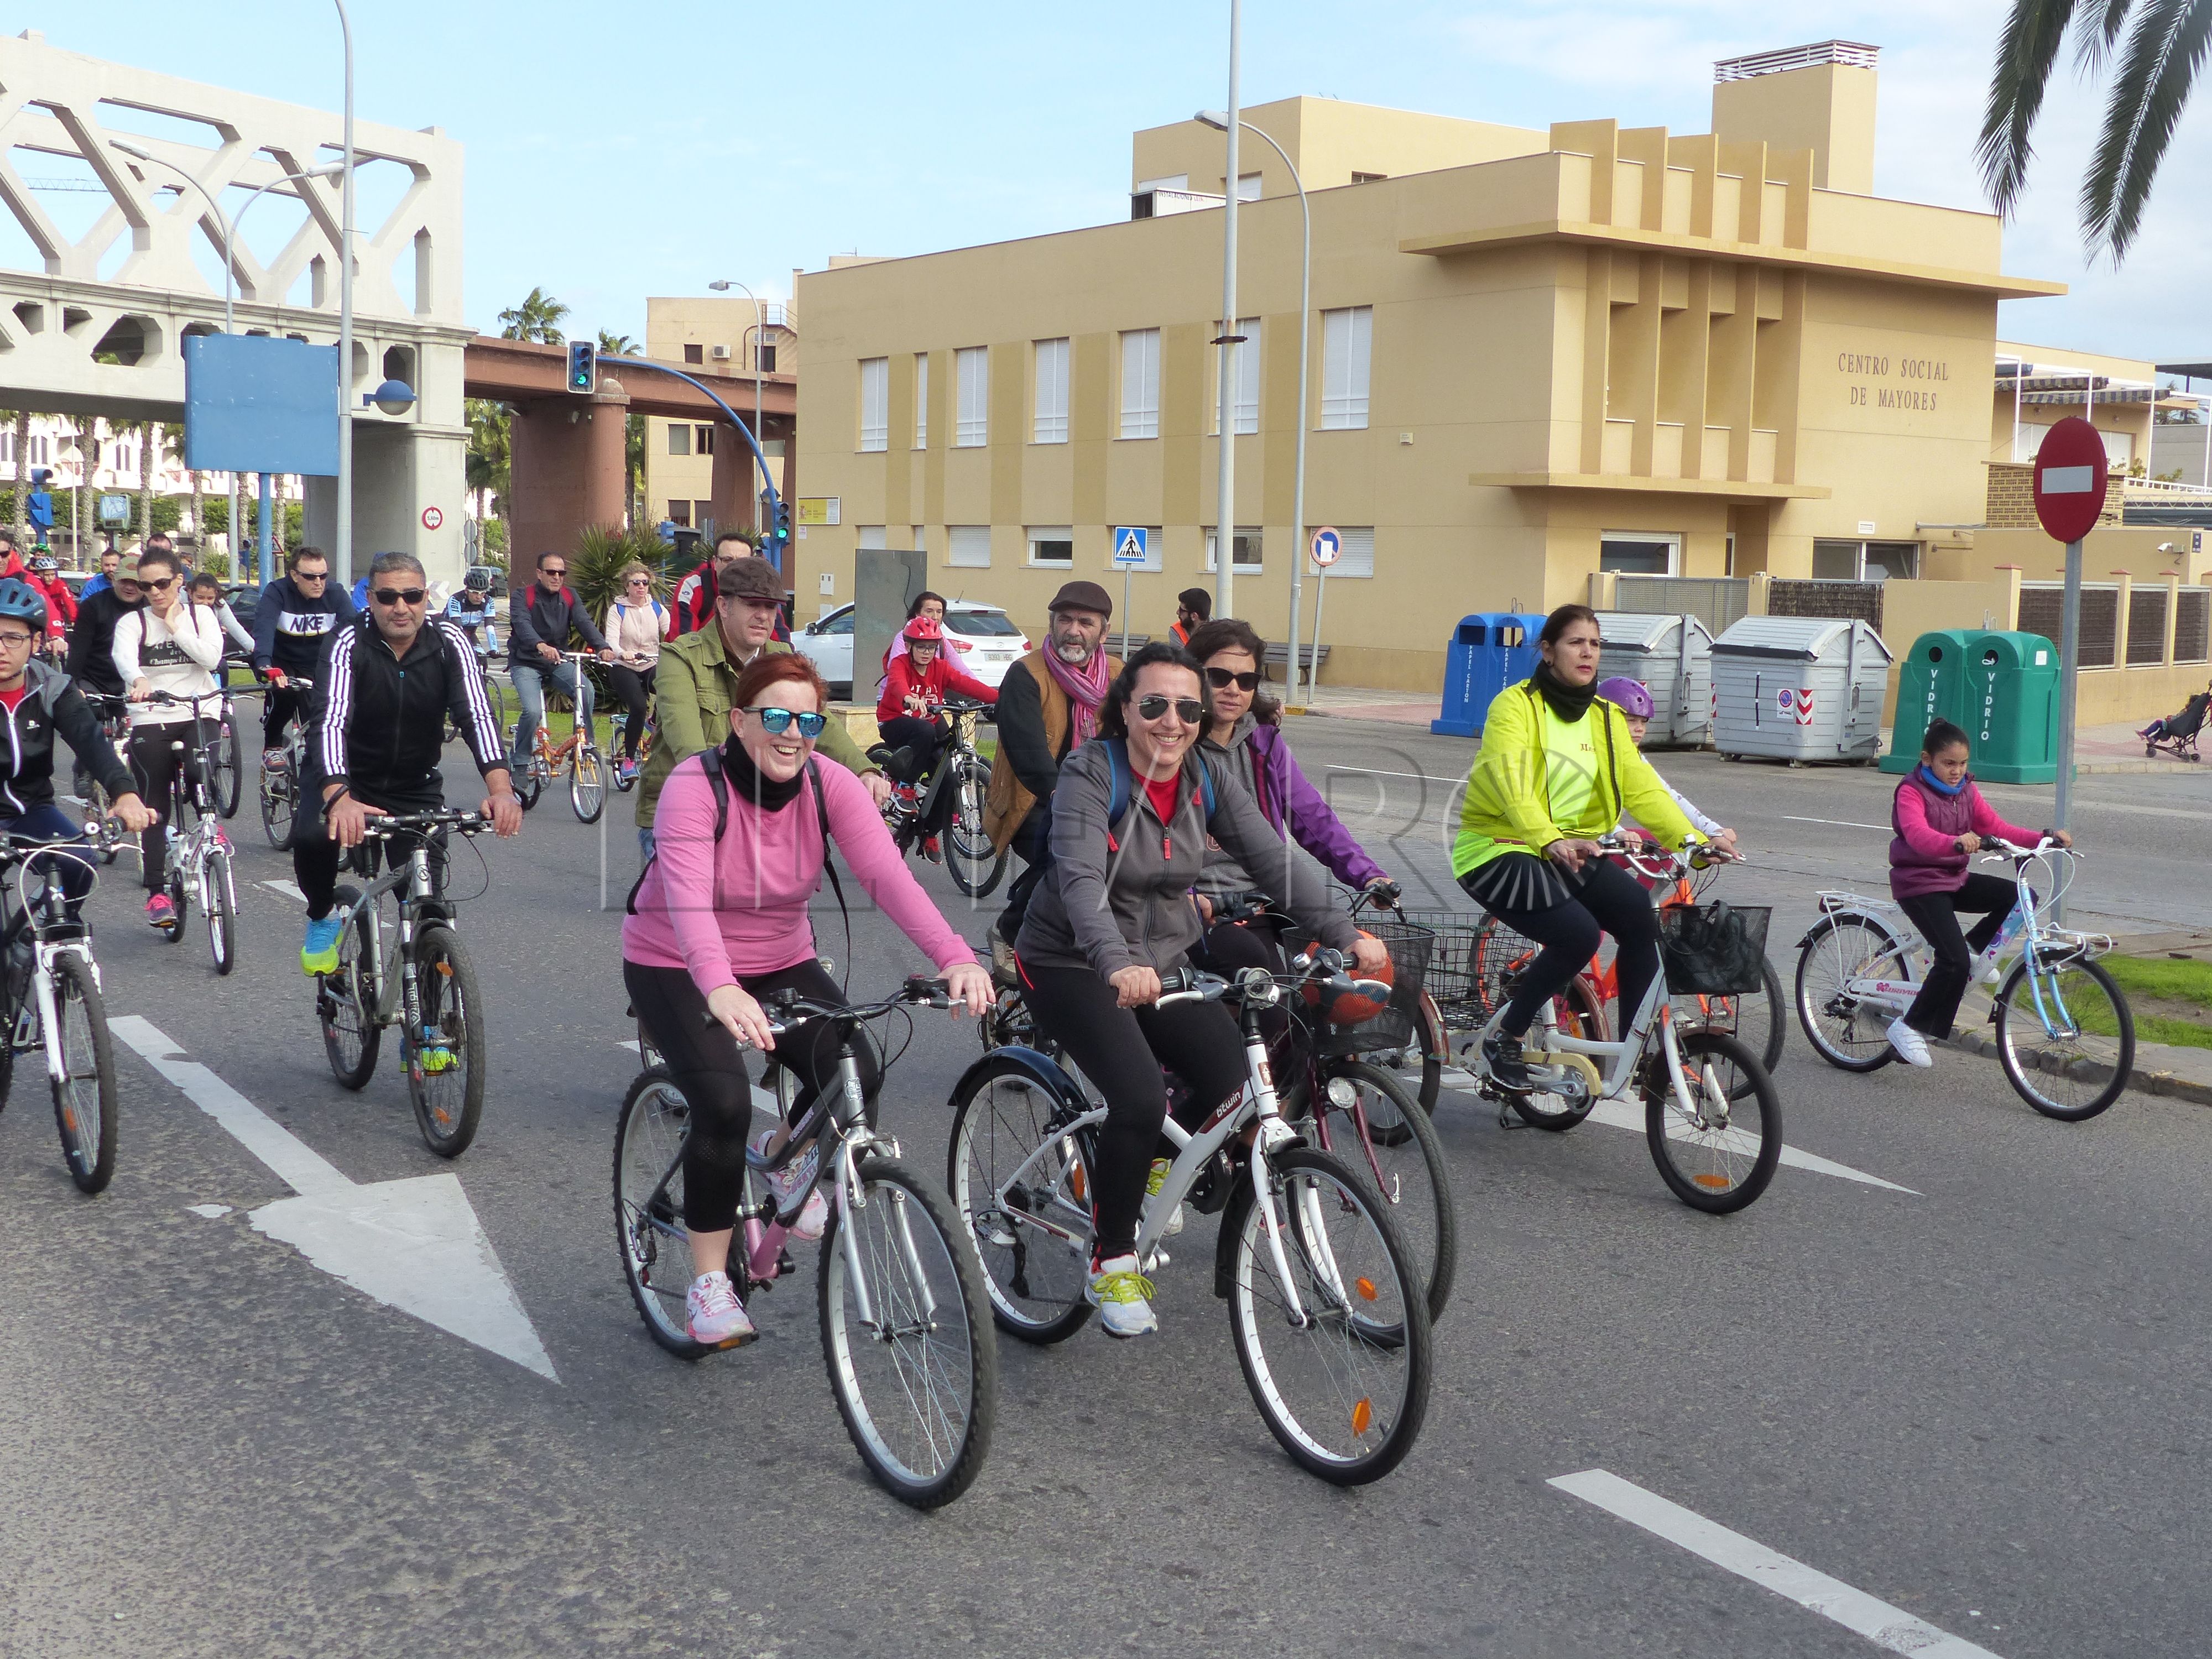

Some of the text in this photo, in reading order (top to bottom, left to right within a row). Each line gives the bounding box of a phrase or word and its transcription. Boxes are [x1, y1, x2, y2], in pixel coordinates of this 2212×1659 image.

[1839, 353, 1949, 380] CENTRO SOCIAL
[1850, 387, 1937, 411] DE MAYORES
[289, 616, 325, 632] NIKE
[1924, 669, 1938, 734] VIDRI
[1981, 672, 1995, 740] VIDRIO
